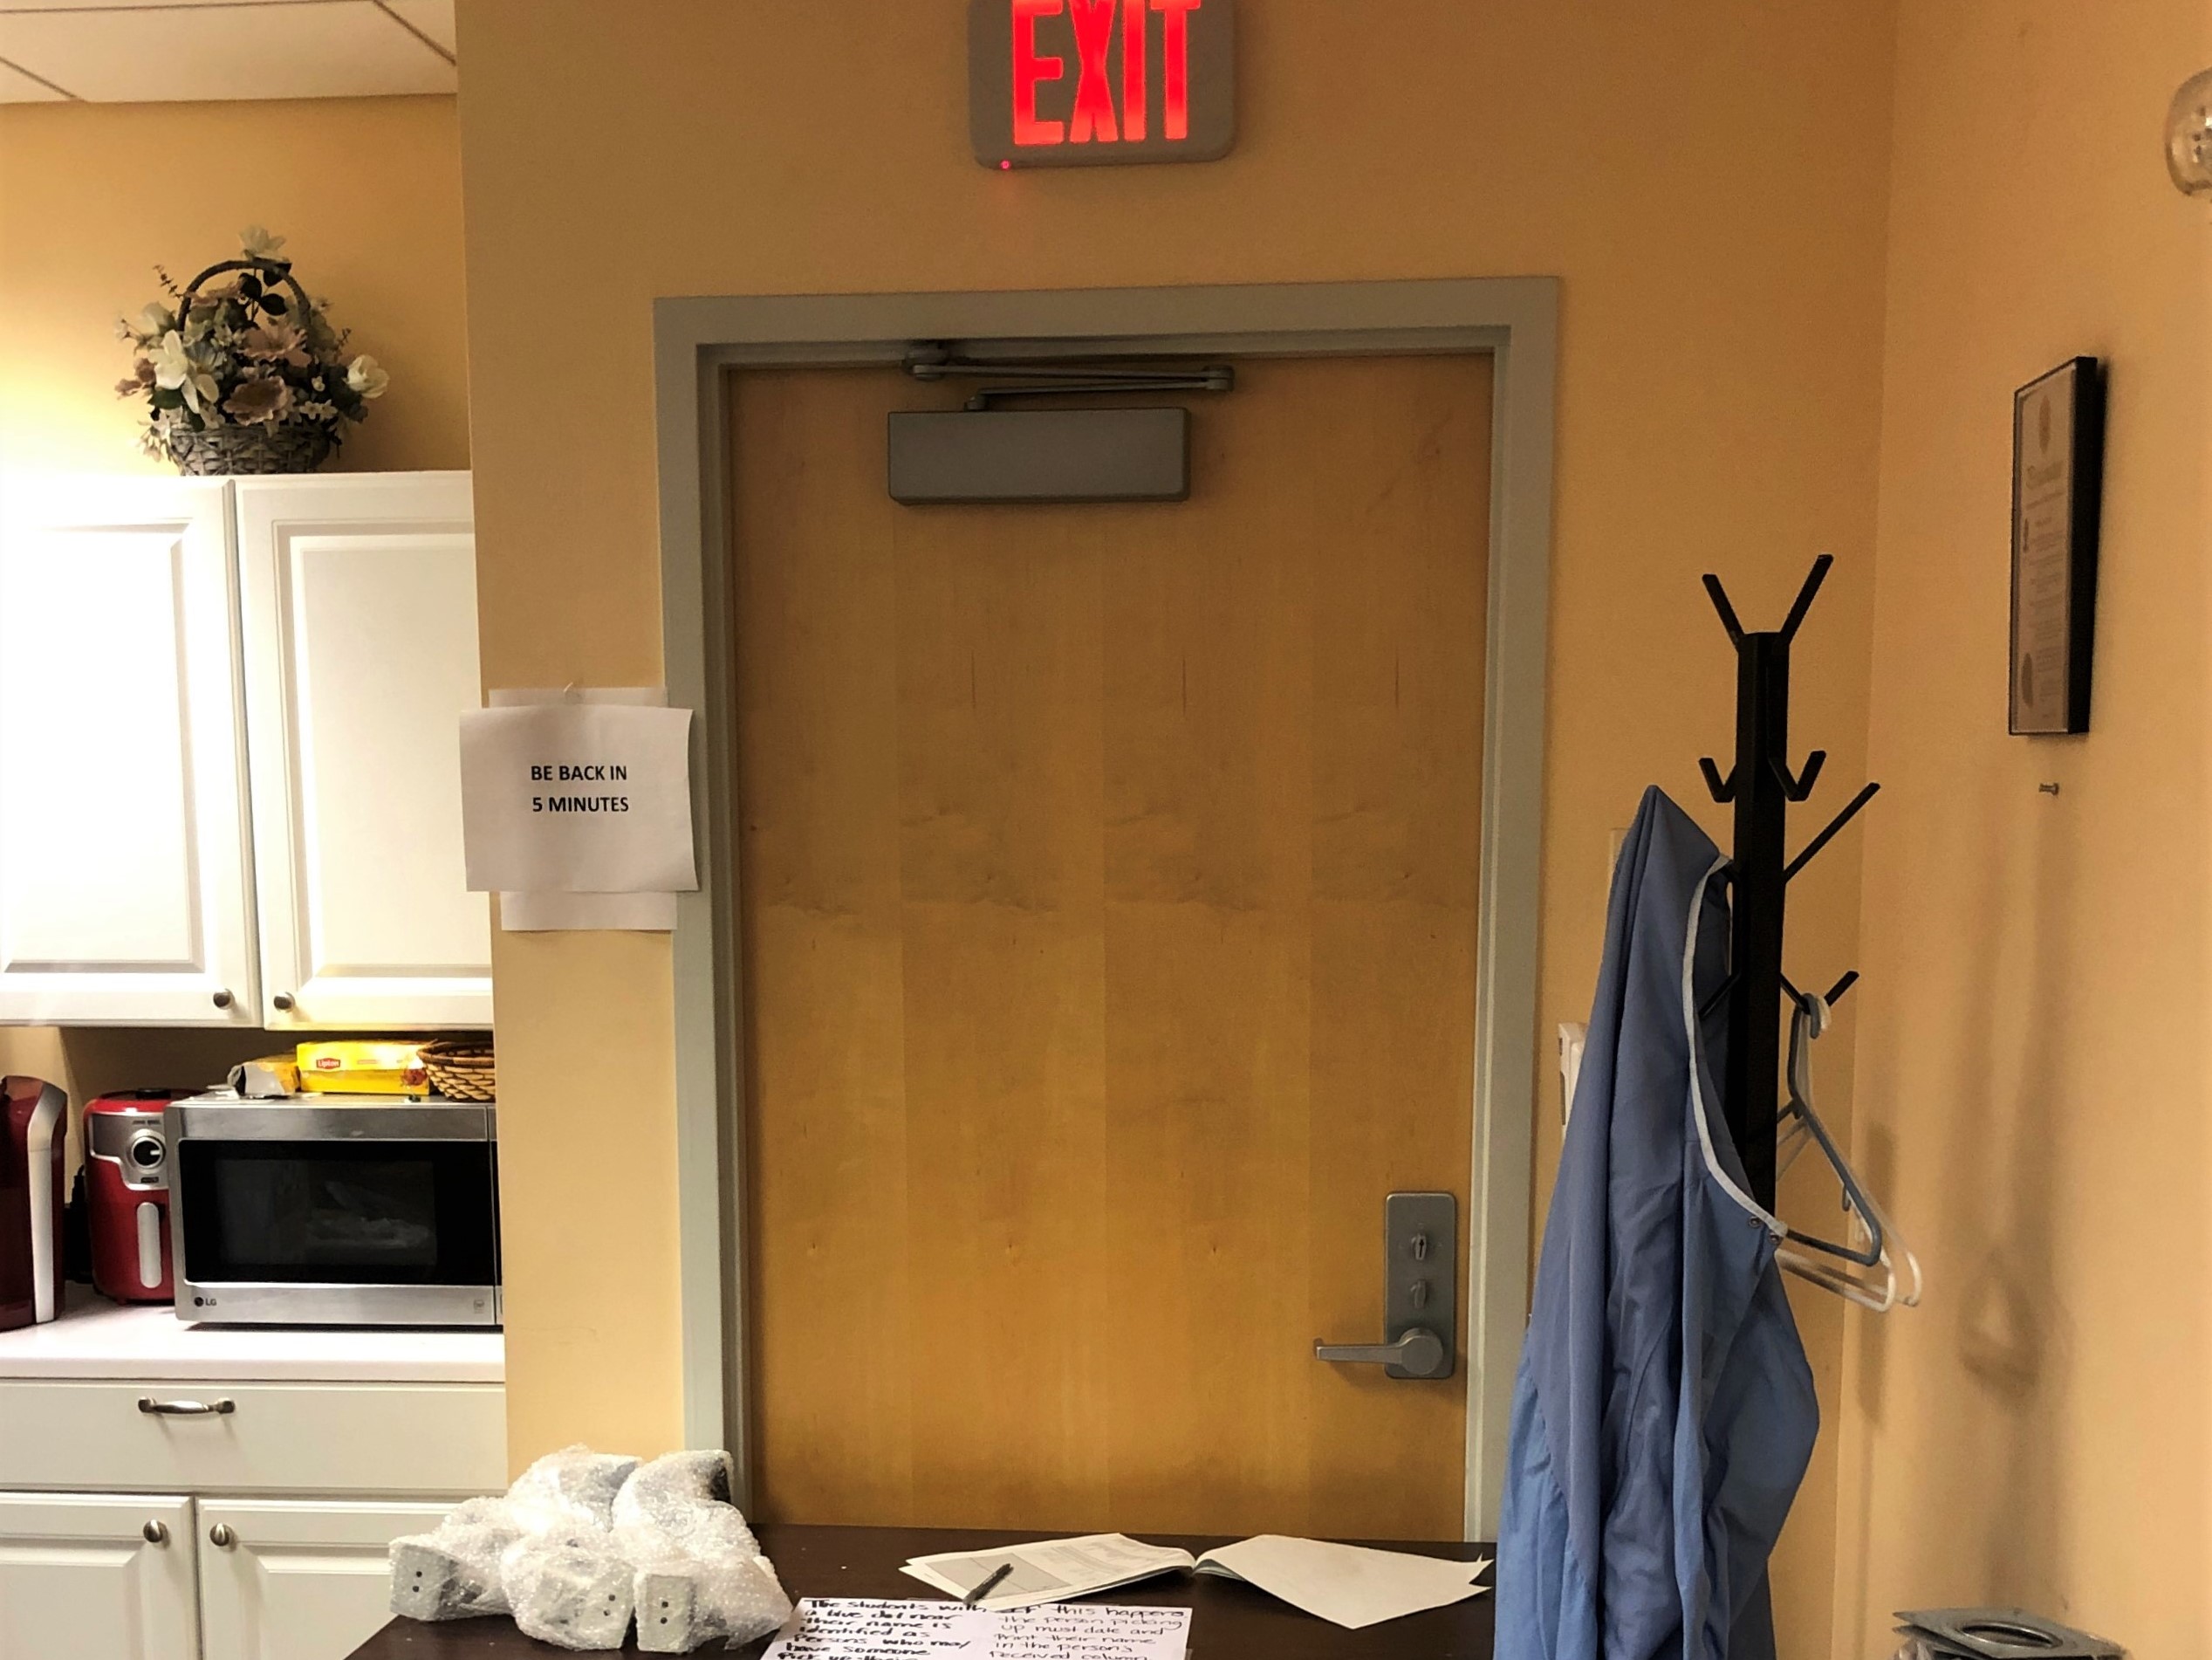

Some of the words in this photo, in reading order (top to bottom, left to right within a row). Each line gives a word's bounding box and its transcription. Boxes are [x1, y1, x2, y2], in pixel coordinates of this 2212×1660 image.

[1012, 0, 1201, 146] EXIT
[531, 765, 553, 781] BE
[558, 765, 606, 781] BACK
[610, 765, 627, 781] IN
[532, 797, 543, 812] 5
[548, 797, 629, 812] MINUTES
[318, 1060, 339, 1069] Lipton
[804, 1599, 840, 1609] The
[938, 1604, 987, 1613] with
[1051, 1605, 1096, 1615] this
[827, 1609, 864, 1618] blue
[871, 1610, 904, 1619] dot
[800, 1617, 857, 1626] their
[786, 1642, 831, 1651] have
[930, 1640, 971, 1650] may
